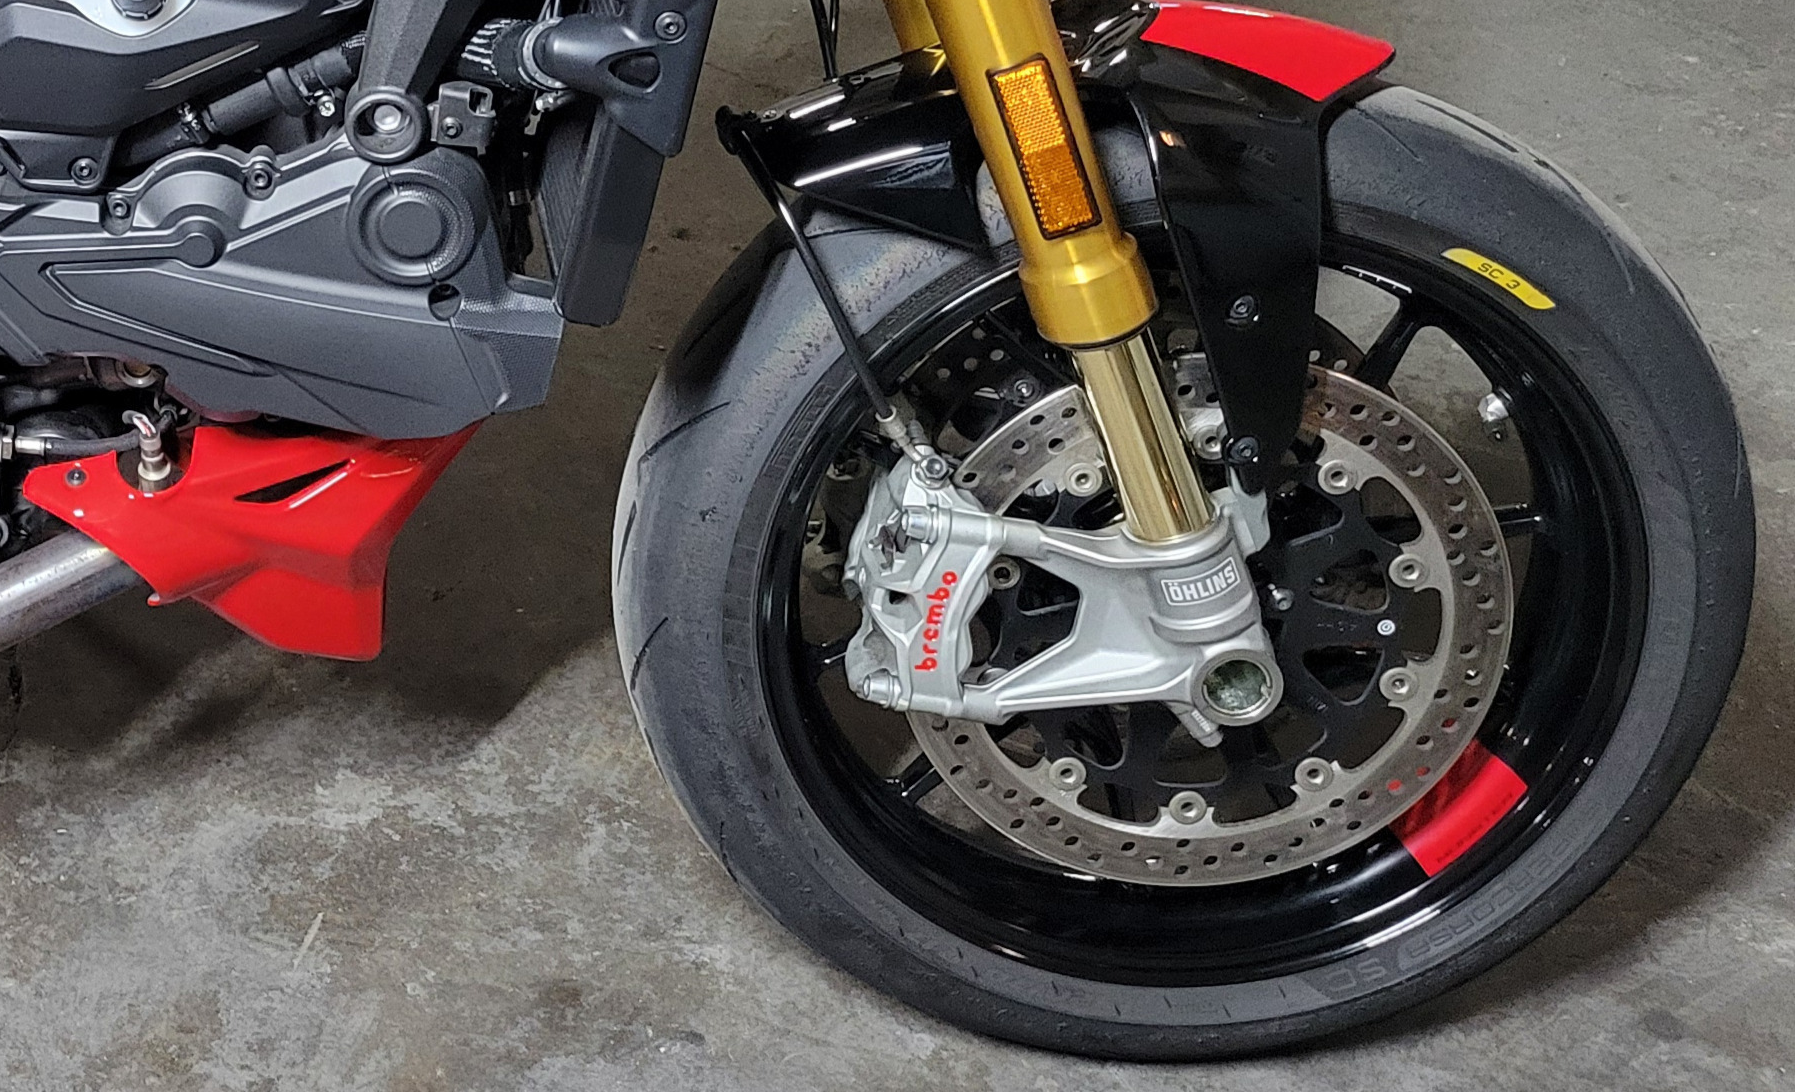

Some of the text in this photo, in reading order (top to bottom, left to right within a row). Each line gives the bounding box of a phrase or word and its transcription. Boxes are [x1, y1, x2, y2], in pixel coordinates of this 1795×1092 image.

[1477, 262, 1521, 290] SC 3
[1167, 565, 1237, 602] ÖHLINS
[914, 570, 958, 672] brembo
